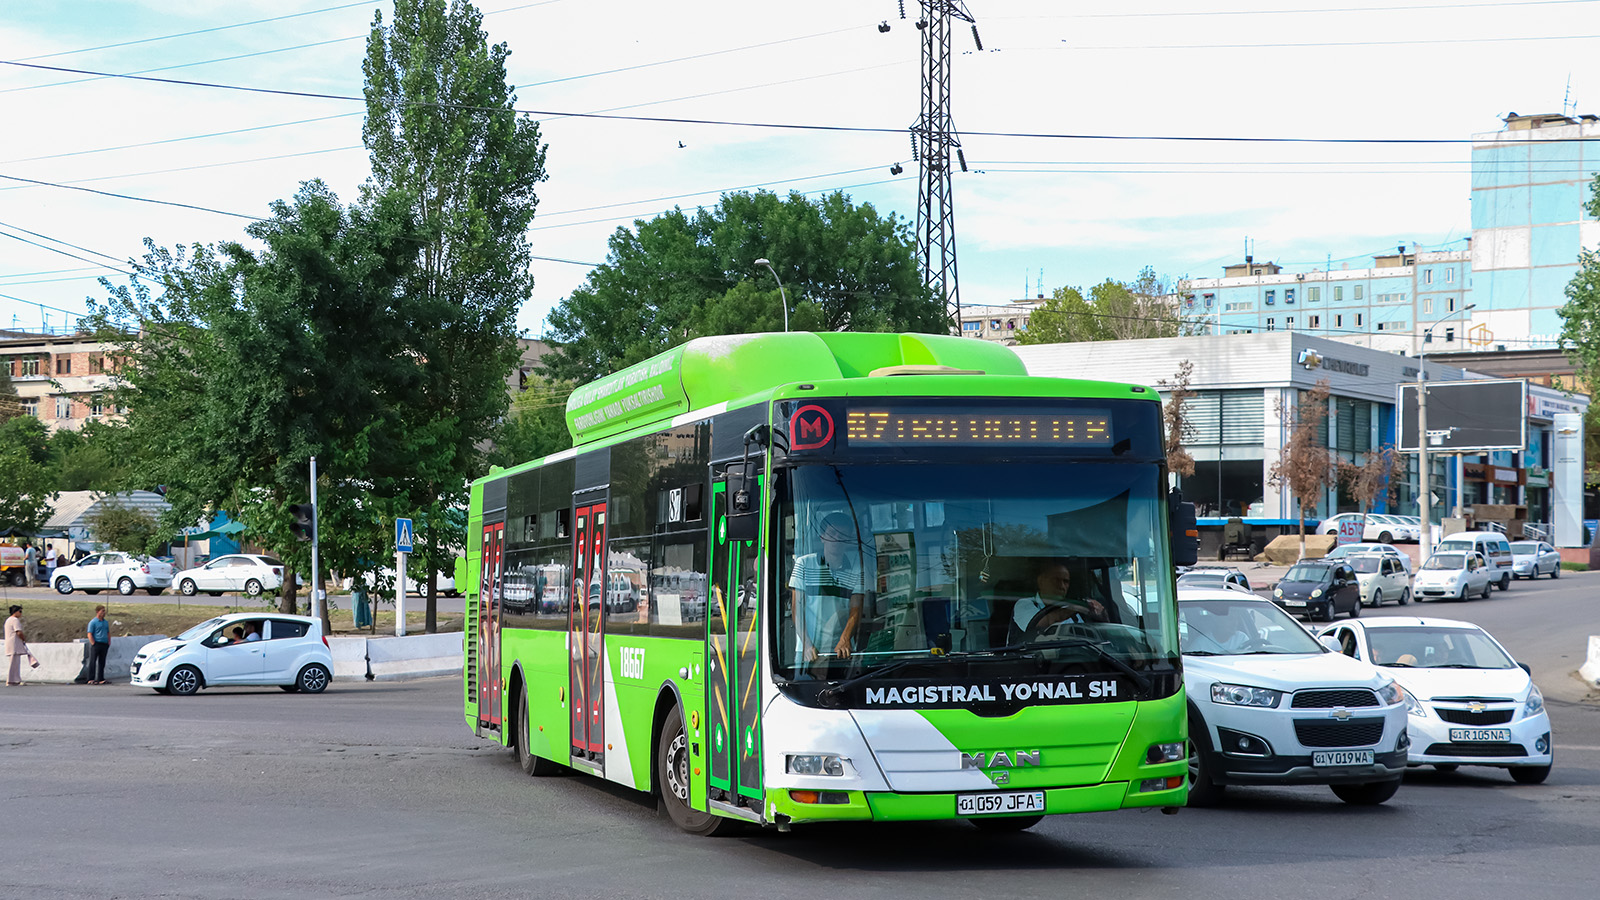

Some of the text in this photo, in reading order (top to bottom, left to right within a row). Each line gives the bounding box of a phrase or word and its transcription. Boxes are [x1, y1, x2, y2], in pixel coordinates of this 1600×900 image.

[800, 416, 822, 438] M
[669, 490, 681, 521] 87
[619, 646, 646, 680] 18667
[865, 684, 996, 705] MAGISTRAL
[1088, 680, 1118, 698] SH
[1452, 731, 1463, 740] 01
[960, 749, 1041, 770] MAN
[1316, 754, 1326, 764] 01
[961, 794, 1036, 812] 01 059 JFA
